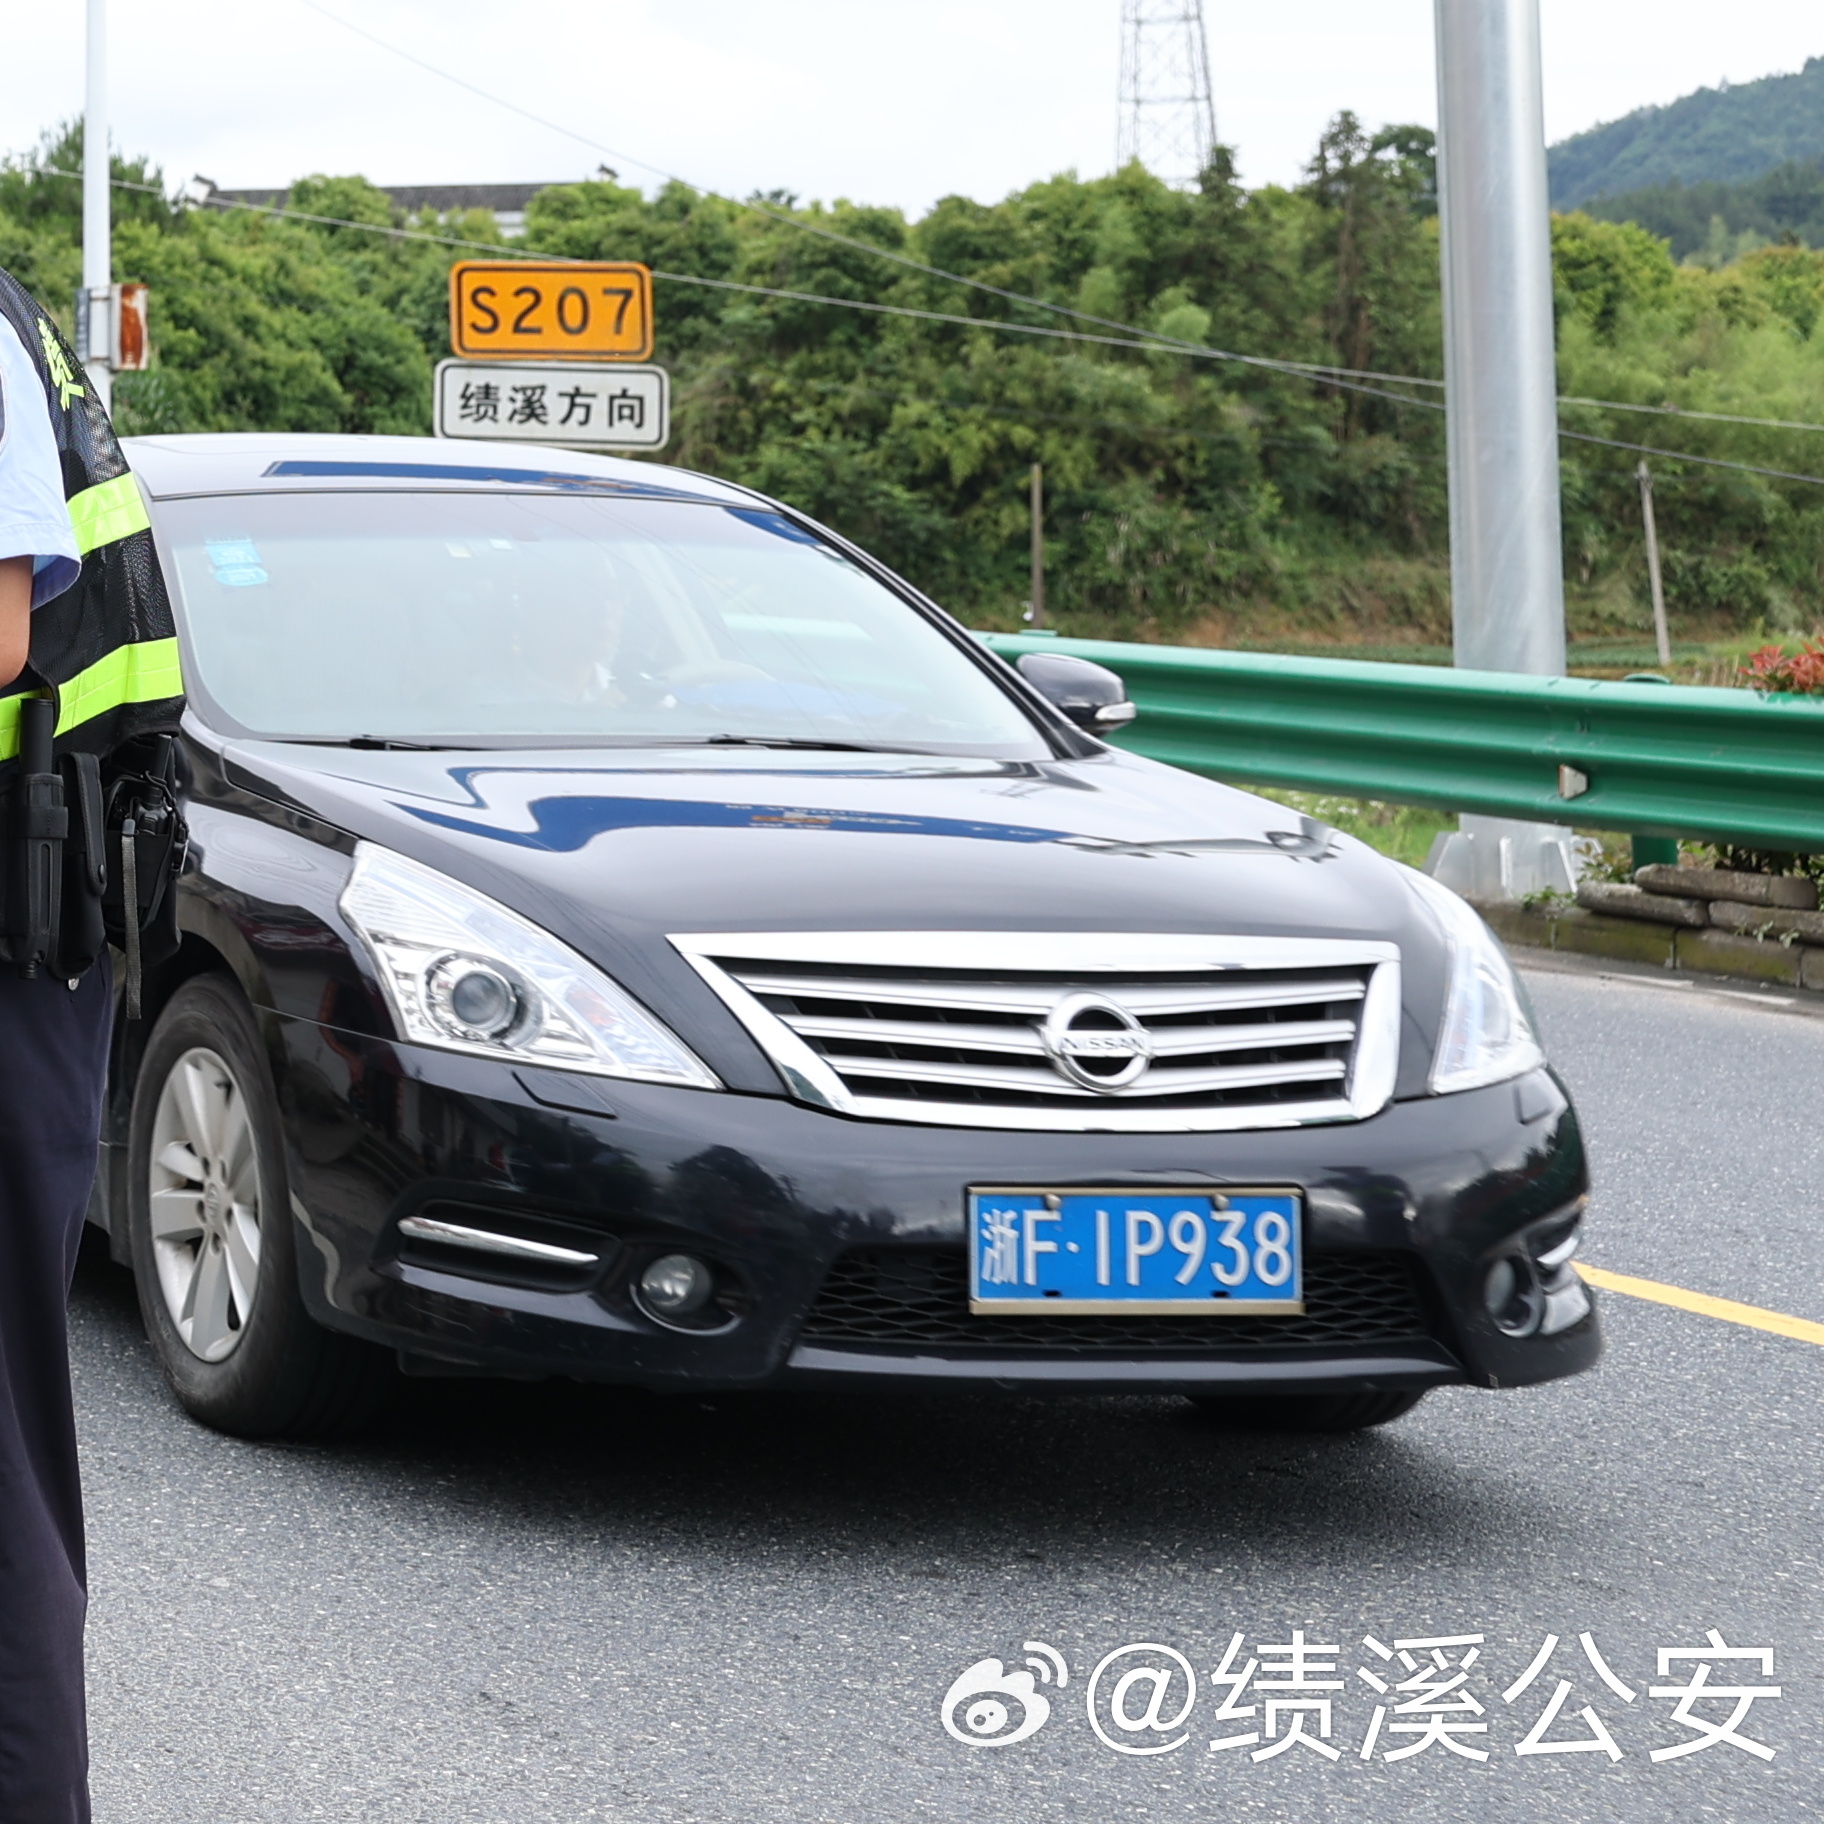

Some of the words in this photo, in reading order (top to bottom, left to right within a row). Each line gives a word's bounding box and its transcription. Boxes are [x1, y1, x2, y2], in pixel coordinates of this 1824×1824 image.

[469, 286, 635, 336] S207
[459, 382, 646, 429] 绩溪方向
